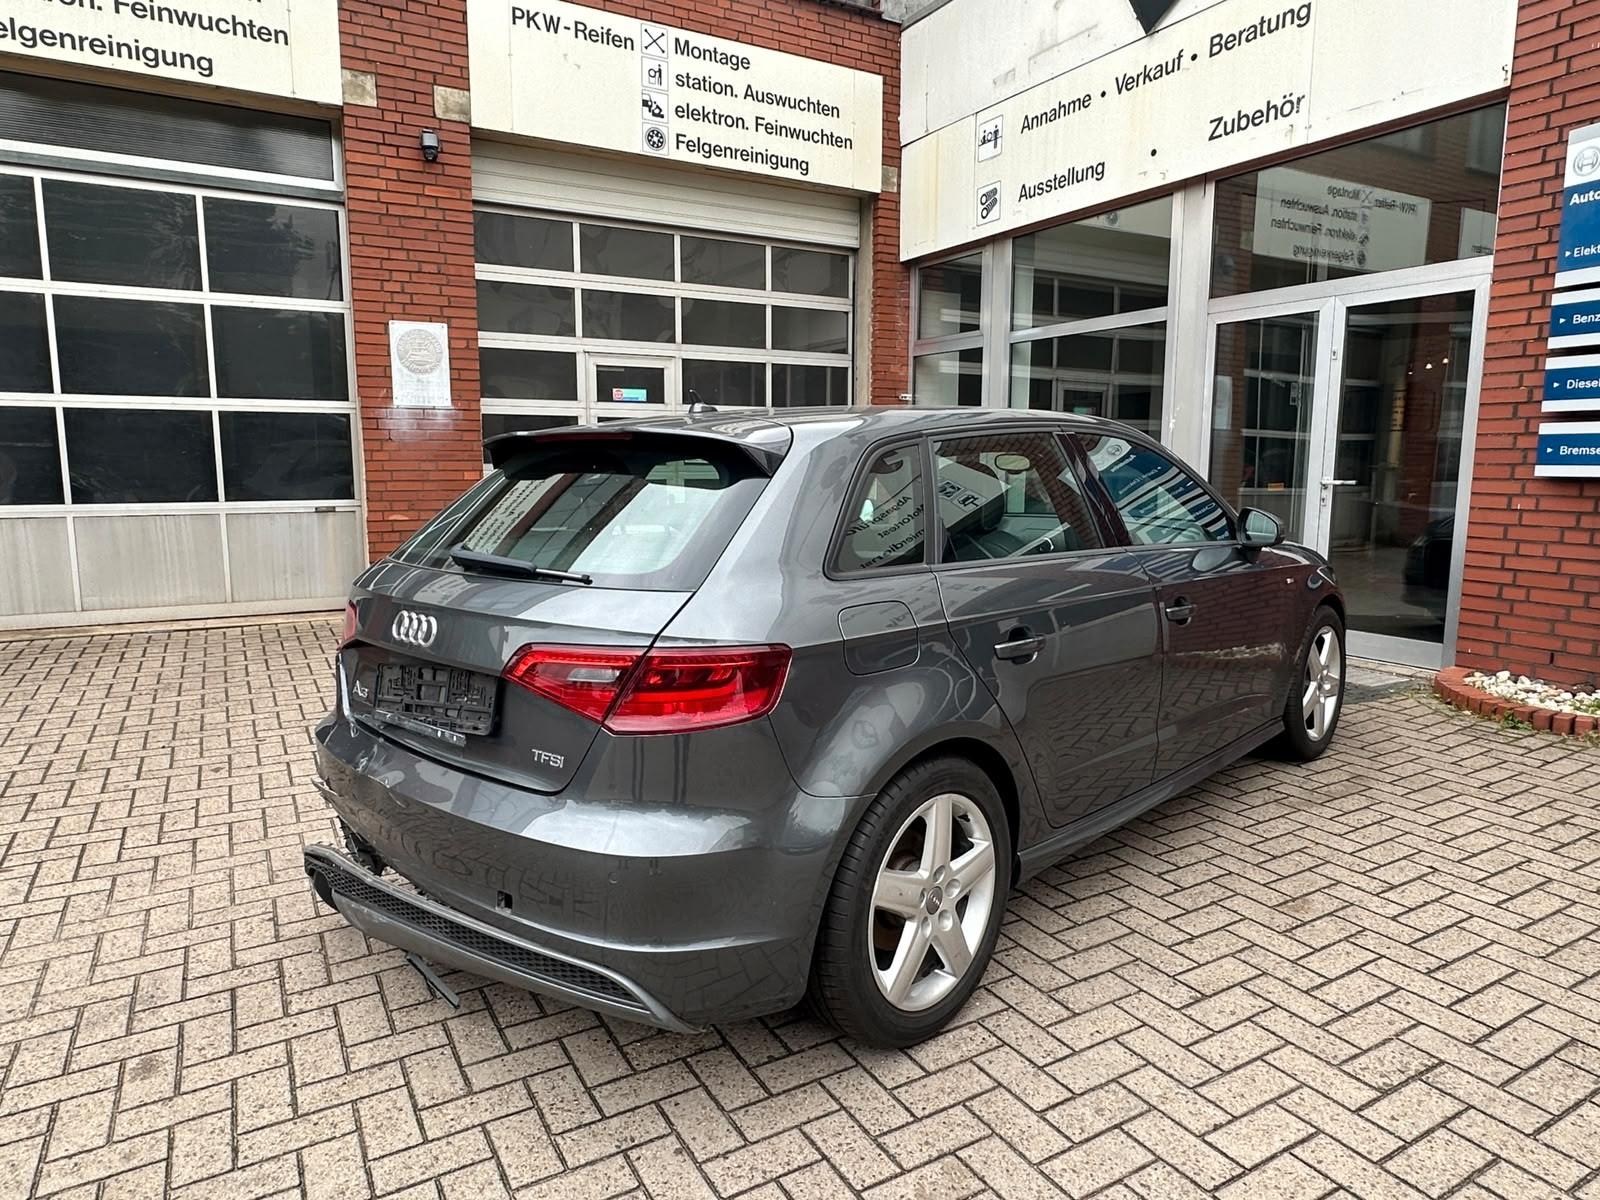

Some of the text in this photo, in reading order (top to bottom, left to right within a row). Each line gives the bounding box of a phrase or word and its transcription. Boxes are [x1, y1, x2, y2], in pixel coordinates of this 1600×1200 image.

[114, 0, 289, 46] Feinwuchten
[511, 6, 635, 51] PKW-Reifen
[674, 37, 751, 71] Montage
[1020, 2, 1312, 135] Annahme Verkauf Beratung
[675, 72, 840, 119] station. Auswuchten
[1208, 92, 1306, 142] Zubehör
[674, 103, 853, 150] elektron. Feinwuchten
[675, 133, 809, 176] Felgenreinigung
[1018, 160, 1106, 203] Ausstellung
[353, 679, 369, 699] A3
[531, 748, 565, 769] TFSI
